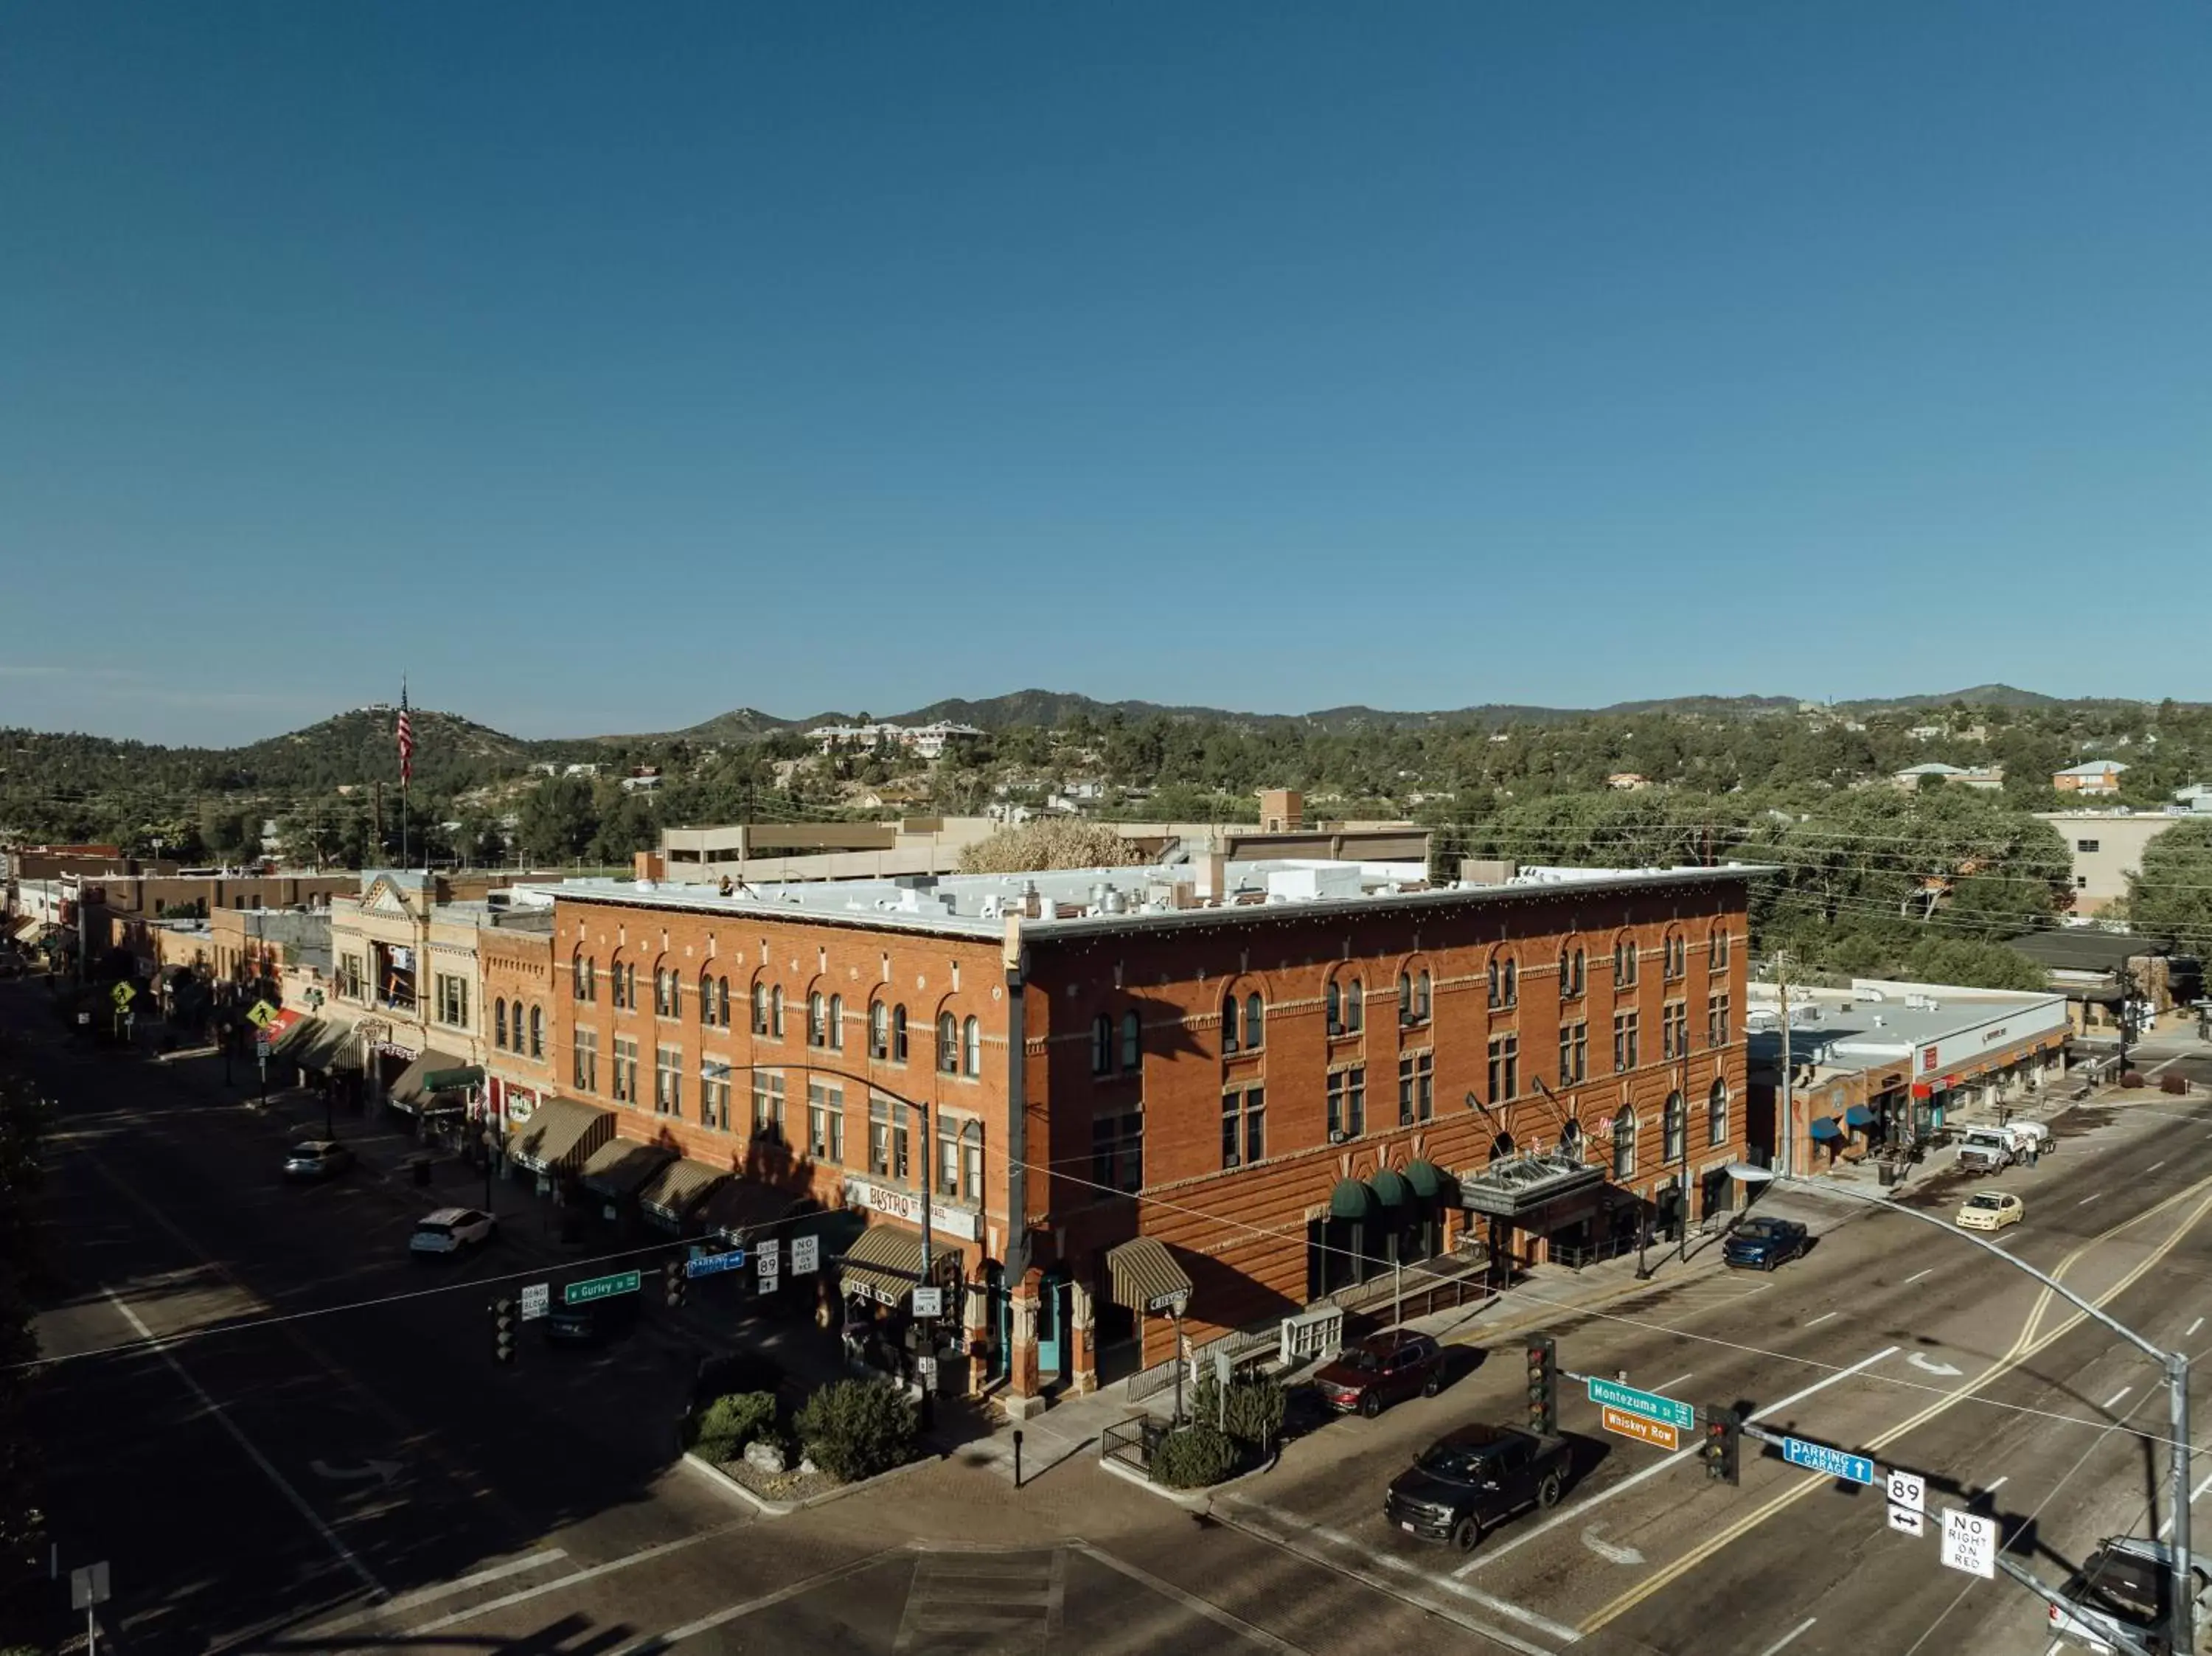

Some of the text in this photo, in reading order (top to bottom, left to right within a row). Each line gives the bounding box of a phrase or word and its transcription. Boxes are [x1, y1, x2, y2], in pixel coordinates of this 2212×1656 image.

[870, 1187, 908, 1217] BISTRO
[797, 1239, 813, 1249] NO
[760, 1259, 776, 1273] 89
[582, 1283, 612, 1298] Gurley
[1595, 1383, 1658, 1413] Montezuma
[1609, 1412, 1672, 1441] Whiskey Row
[1791, 1441, 1849, 1464] PARKING
[1804, 1455, 1849, 1475] GARAGE
[1892, 1479, 1919, 1501] 89
[1954, 1515, 1983, 1535] NO
[1948, 1528, 1986, 1547] RIGHT
[1958, 1544, 1978, 1557] ON
[1955, 1553, 1980, 1569] RED
